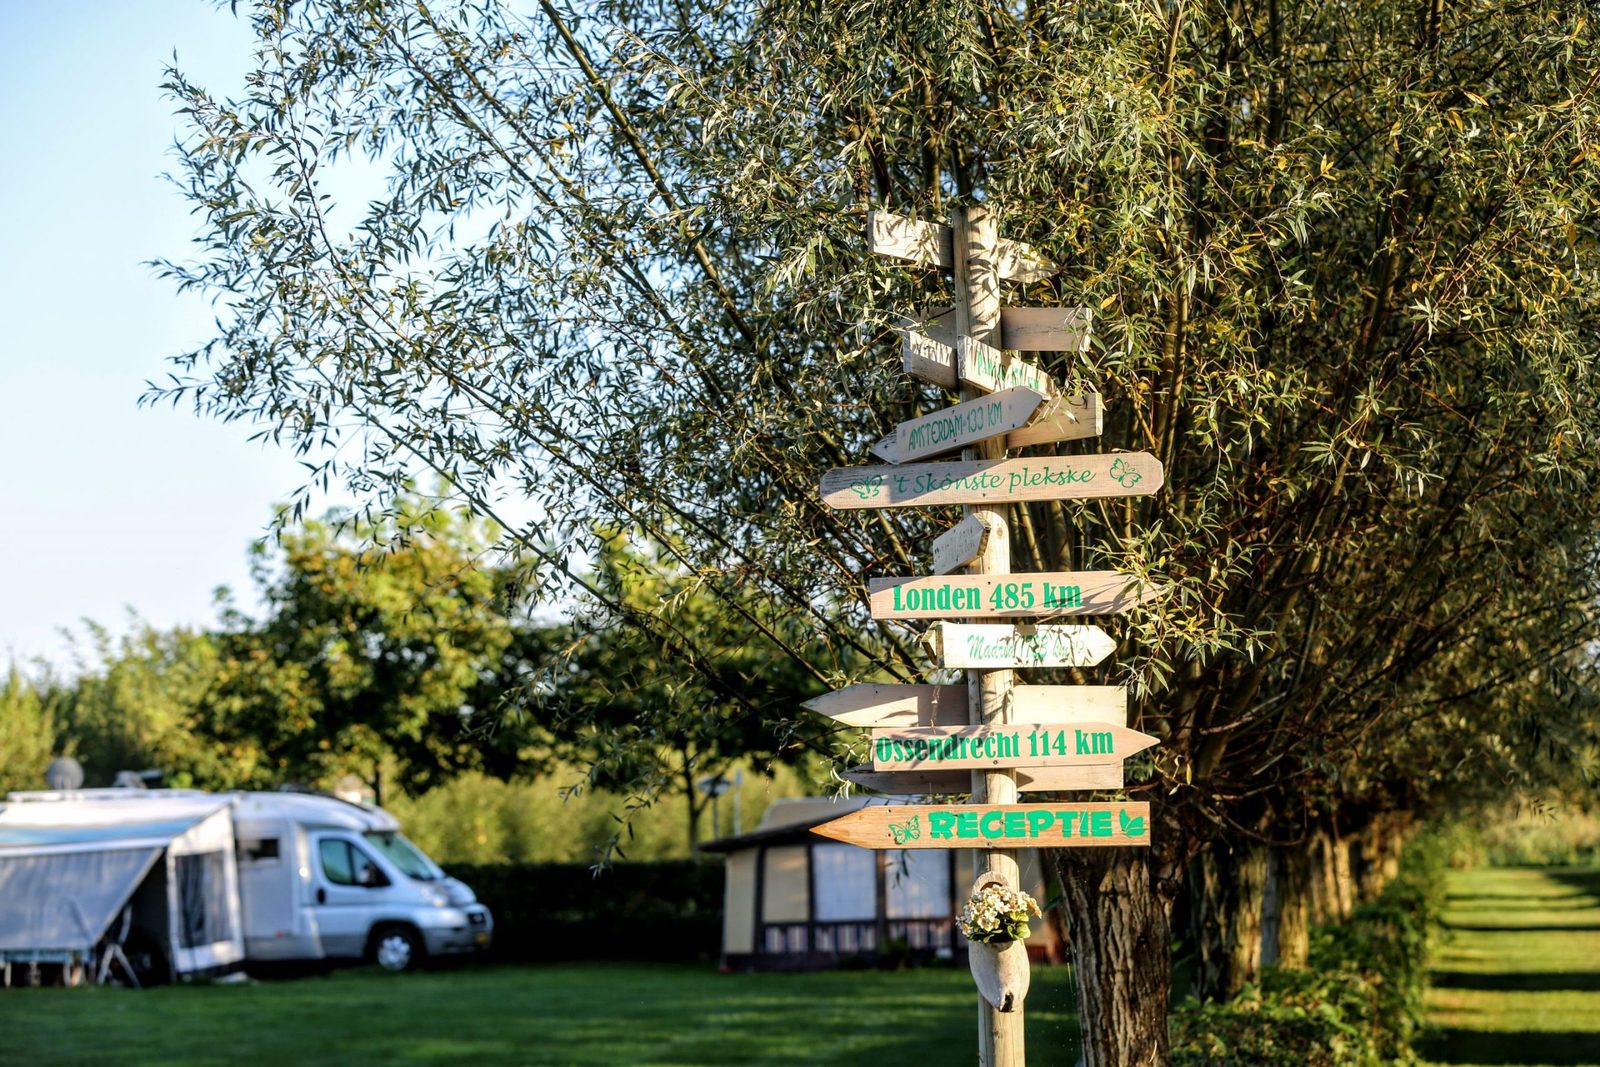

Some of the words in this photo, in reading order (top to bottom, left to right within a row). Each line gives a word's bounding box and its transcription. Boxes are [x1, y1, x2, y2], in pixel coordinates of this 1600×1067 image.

[909, 414, 963, 451] AMSTERDAM
[988, 401, 1003, 427] KM
[892, 474, 908, 494] 't
[1009, 464, 1097, 493] plekske
[893, 584, 981, 611] Londen
[989, 582, 1035, 609] 485
[1043, 582, 1082, 609] km
[967, 634, 1015, 660] Madrid
[875, 731, 1020, 763] Ossendrecht
[1027, 730, 1066, 757] 114
[1075, 729, 1114, 756] km
[928, 809, 1113, 839] RECEPTIE
